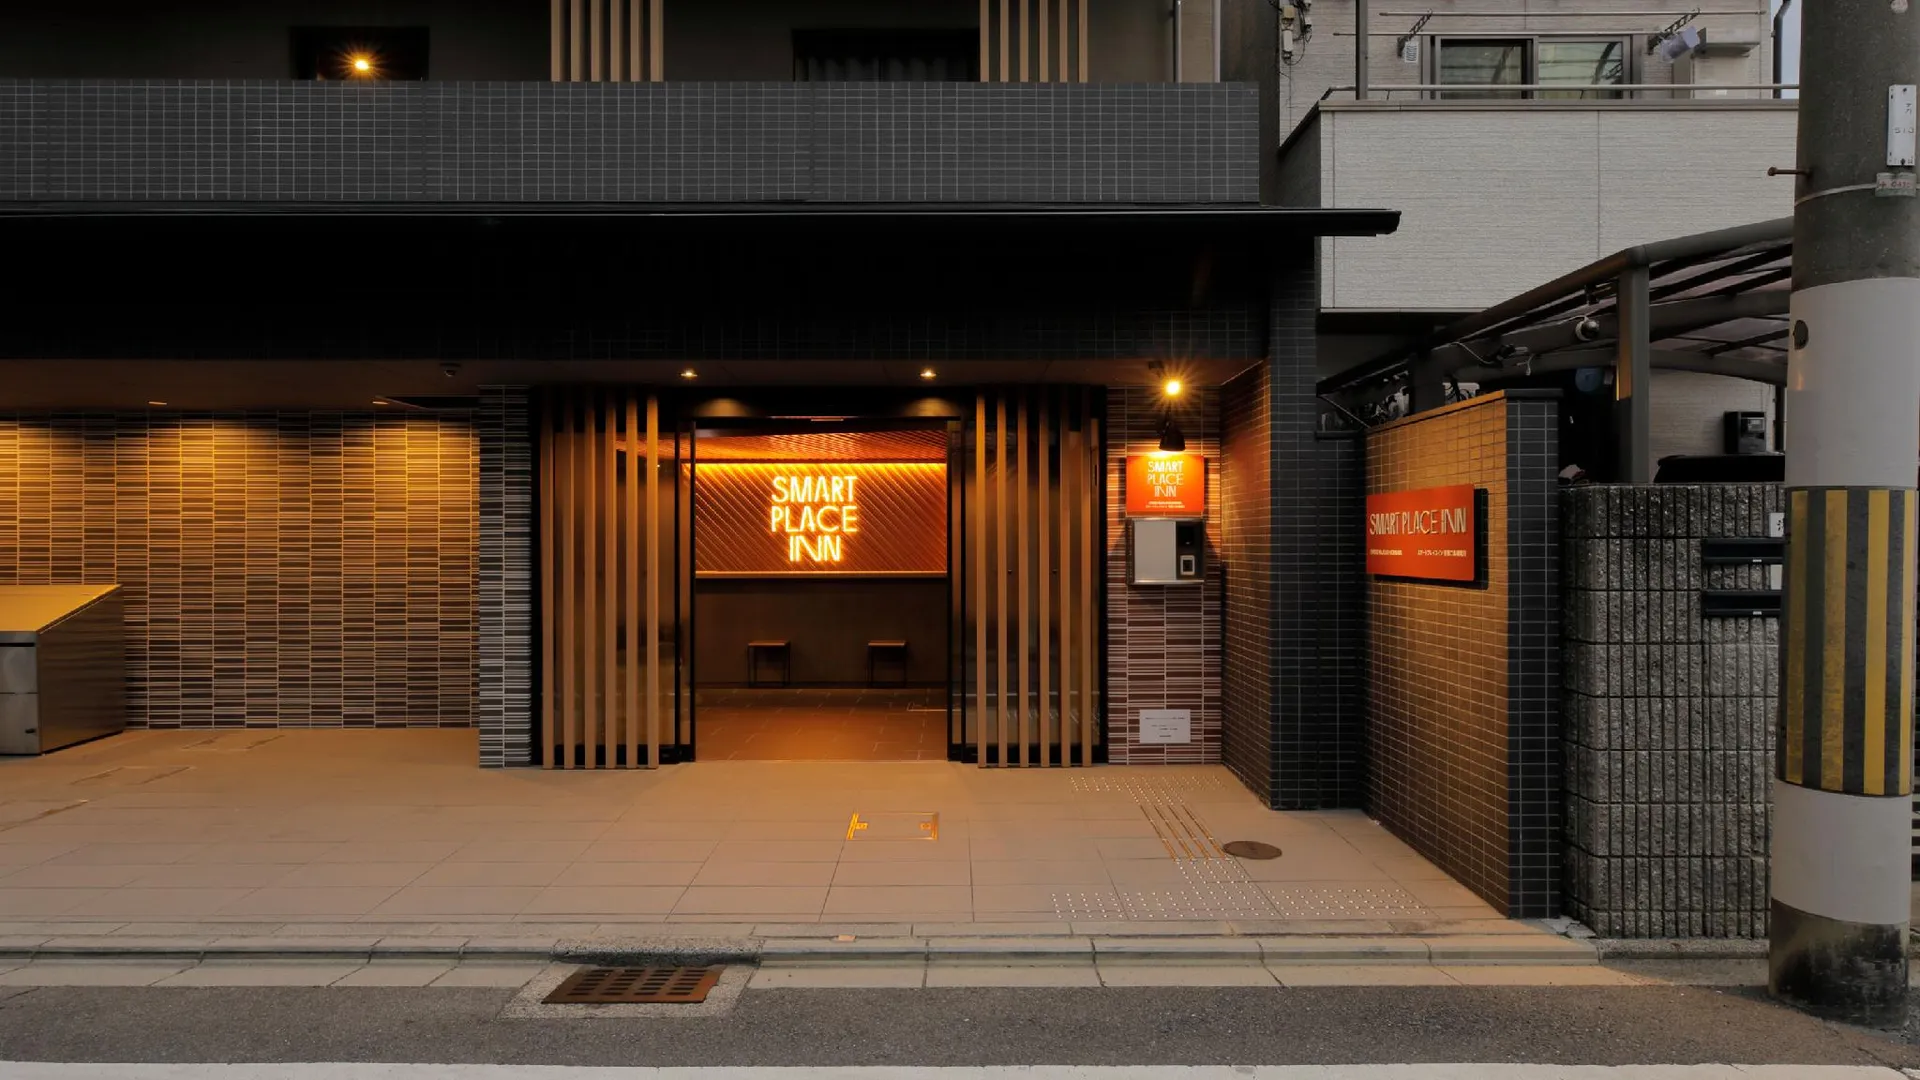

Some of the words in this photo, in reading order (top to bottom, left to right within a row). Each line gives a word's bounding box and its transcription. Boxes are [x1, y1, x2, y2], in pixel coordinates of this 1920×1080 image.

[1147, 461, 1184, 473] SMART
[1147, 473, 1184, 486] PLACE
[772, 475, 858, 502] SMART
[1154, 485, 1177, 497] INN
[771, 505, 858, 532] PLACE
[1369, 512, 1400, 535] SMART
[1401, 510, 1439, 535] PLACE
[1441, 507, 1466, 534] INN
[789, 535, 841, 562] INN
